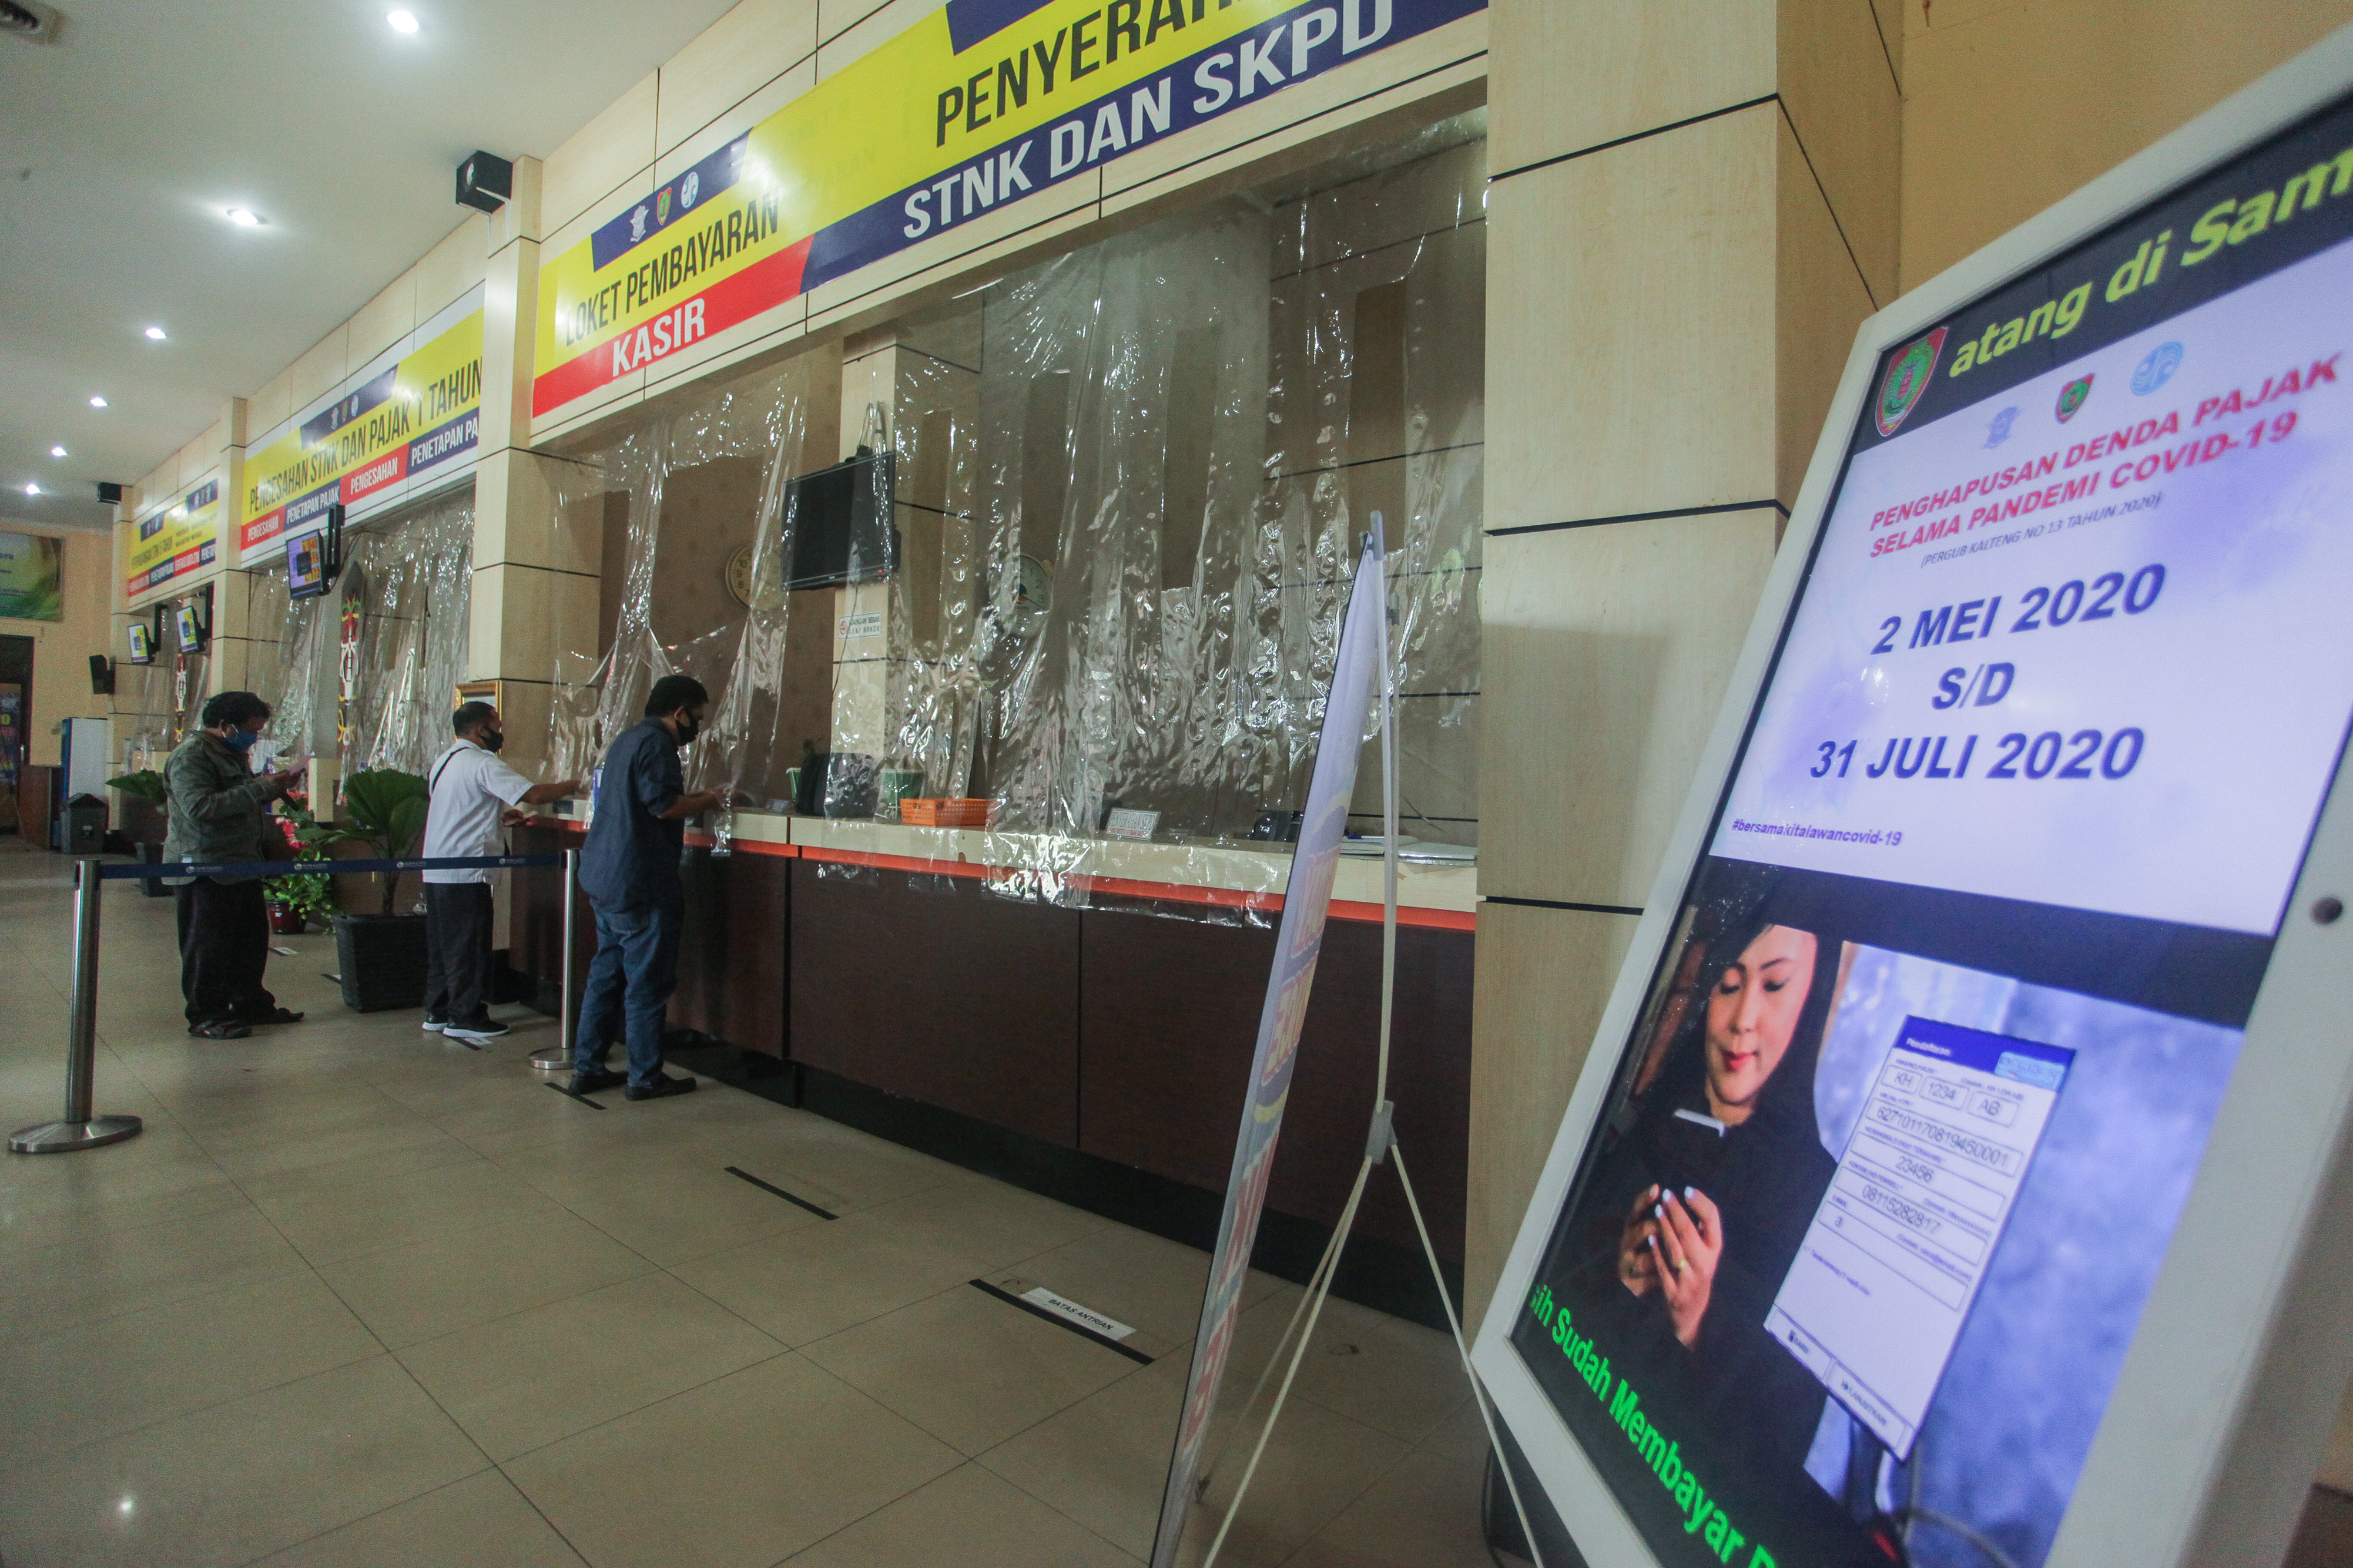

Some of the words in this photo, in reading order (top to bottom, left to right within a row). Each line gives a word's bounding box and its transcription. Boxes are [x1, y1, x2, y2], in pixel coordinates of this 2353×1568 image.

[904, 139, 1034, 240] STNK
[1050, 77, 1171, 172] DAN
[1194, 0, 1392, 113] SKPD
[566, 280, 621, 347] LOKET
[625, 188, 779, 314] PEMBAYARAN
[1949, 282, 2091, 377] atang
[2105, 231, 2171, 303] di
[612, 298, 705, 378] KASIR
[341, 424, 366, 467] DAN
[370, 398, 411, 452] PAJAK
[429, 356, 482, 420] TAHUN
[411, 424, 464, 466] PENETAPAN
[1869, 452, 2058, 531] PENGHAPUSAN
[2063, 411, 2178, 469] DENDA
[2193, 351, 2343, 428] PAJAK
[351, 457, 398, 495] PENGESAHAN
[1870, 515, 1962, 558] SELAMA
[1967, 471, 2101, 531] PANDEMI
[2110, 411, 2298, 489] COVID-19
[287, 496, 319, 524] PENETAPAN
[320, 485, 340, 509] PAJAK
[2023, 525, 2045, 539] NO
[2066, 503, 2117, 529] TAHUN
[1869, 615, 1902, 655] 2
[1908, 596, 2002, 650] MEI
[2009, 563, 2166, 633] 2020
[1931, 662, 2016, 710] S/D
[1810, 739, 1858, 778] 31
[1865, 734, 1979, 779] JULI
[1985, 727, 2145, 780] 2020
[1732, 818, 1903, 847] #bersamakitalawancovid-19
[1929, 1083, 1958, 1101] 1234
[1895, 1155, 1935, 1183] 23456
[1048, 1299, 1077, 1313] BATAS
[1076, 1312, 1114, 1330] ANTRIAN
[1552, 1308, 1612, 1402] Sudah
[1610, 1378, 1745, 1564] Membayar
